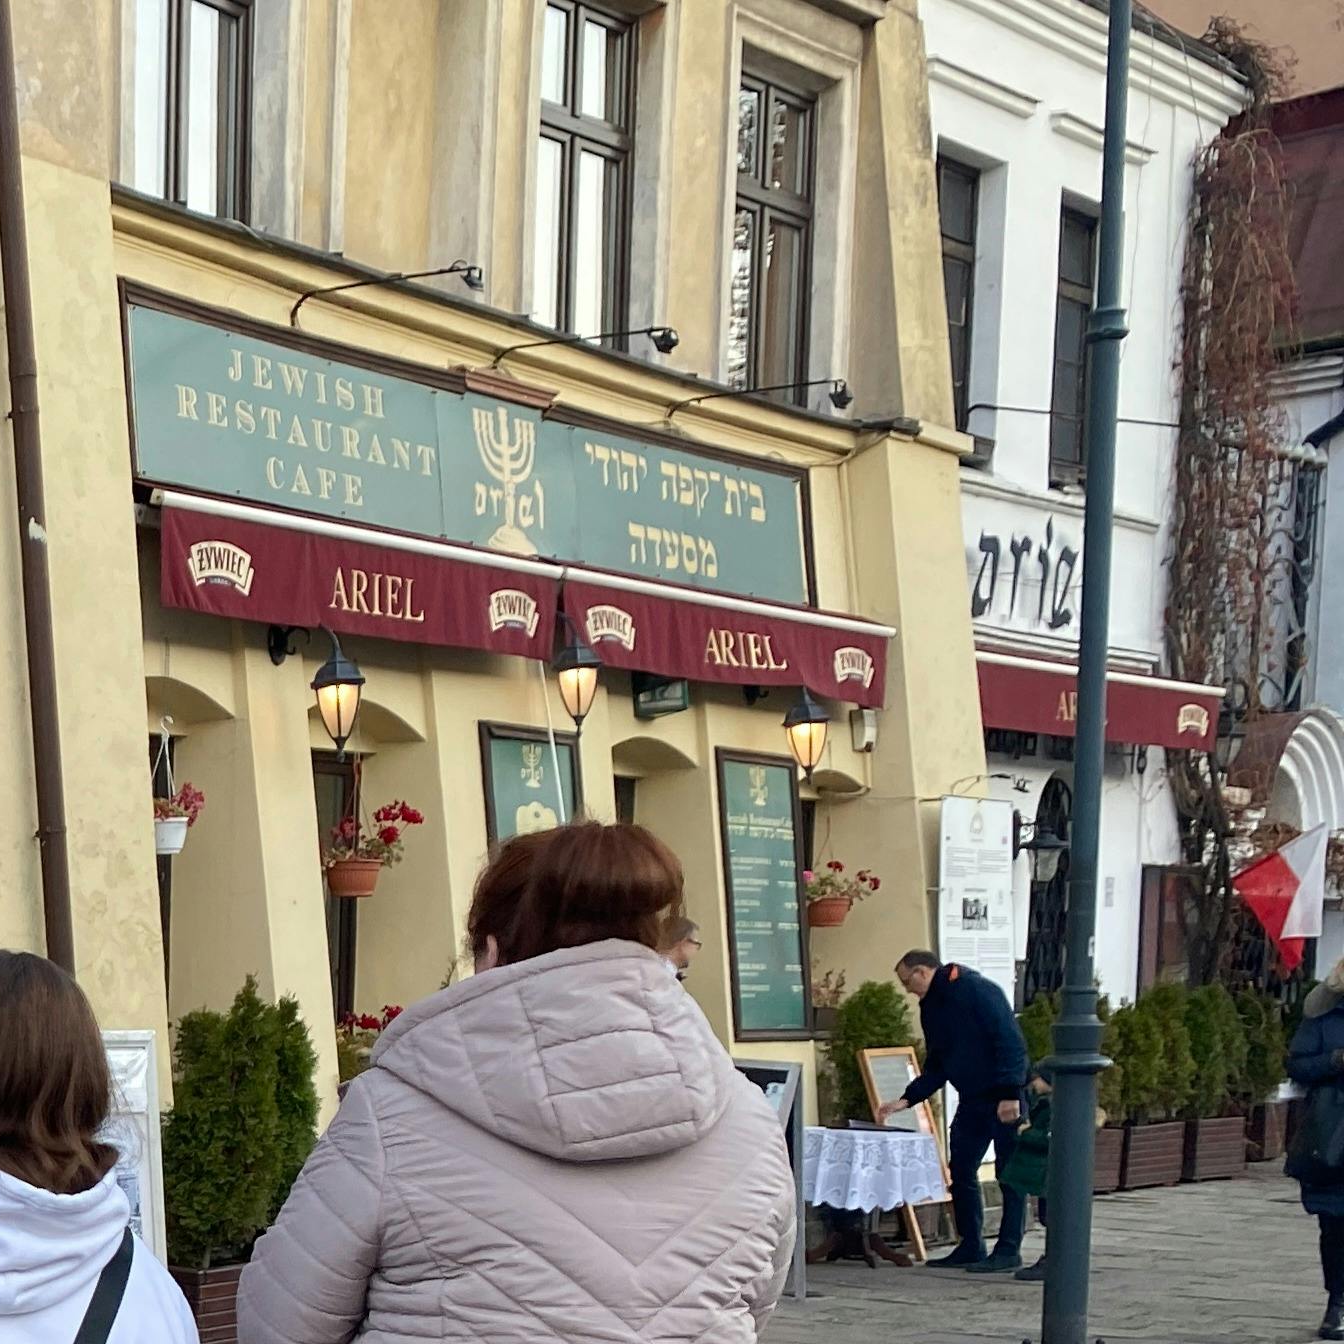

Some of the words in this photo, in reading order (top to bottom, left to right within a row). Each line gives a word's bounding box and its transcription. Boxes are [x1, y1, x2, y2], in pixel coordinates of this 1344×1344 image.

[228, 349, 386, 418] JEWISH
[175, 384, 435, 476] RESTAURANT
[266, 456, 363, 506] CAFE
[583, 441, 648, 493] יהודי
[196, 543, 246, 578] ŻYWIEC
[627, 520, 719, 578] מסעדה
[329, 566, 425, 622] ARIEL
[703, 627, 788, 671] ARIEL
